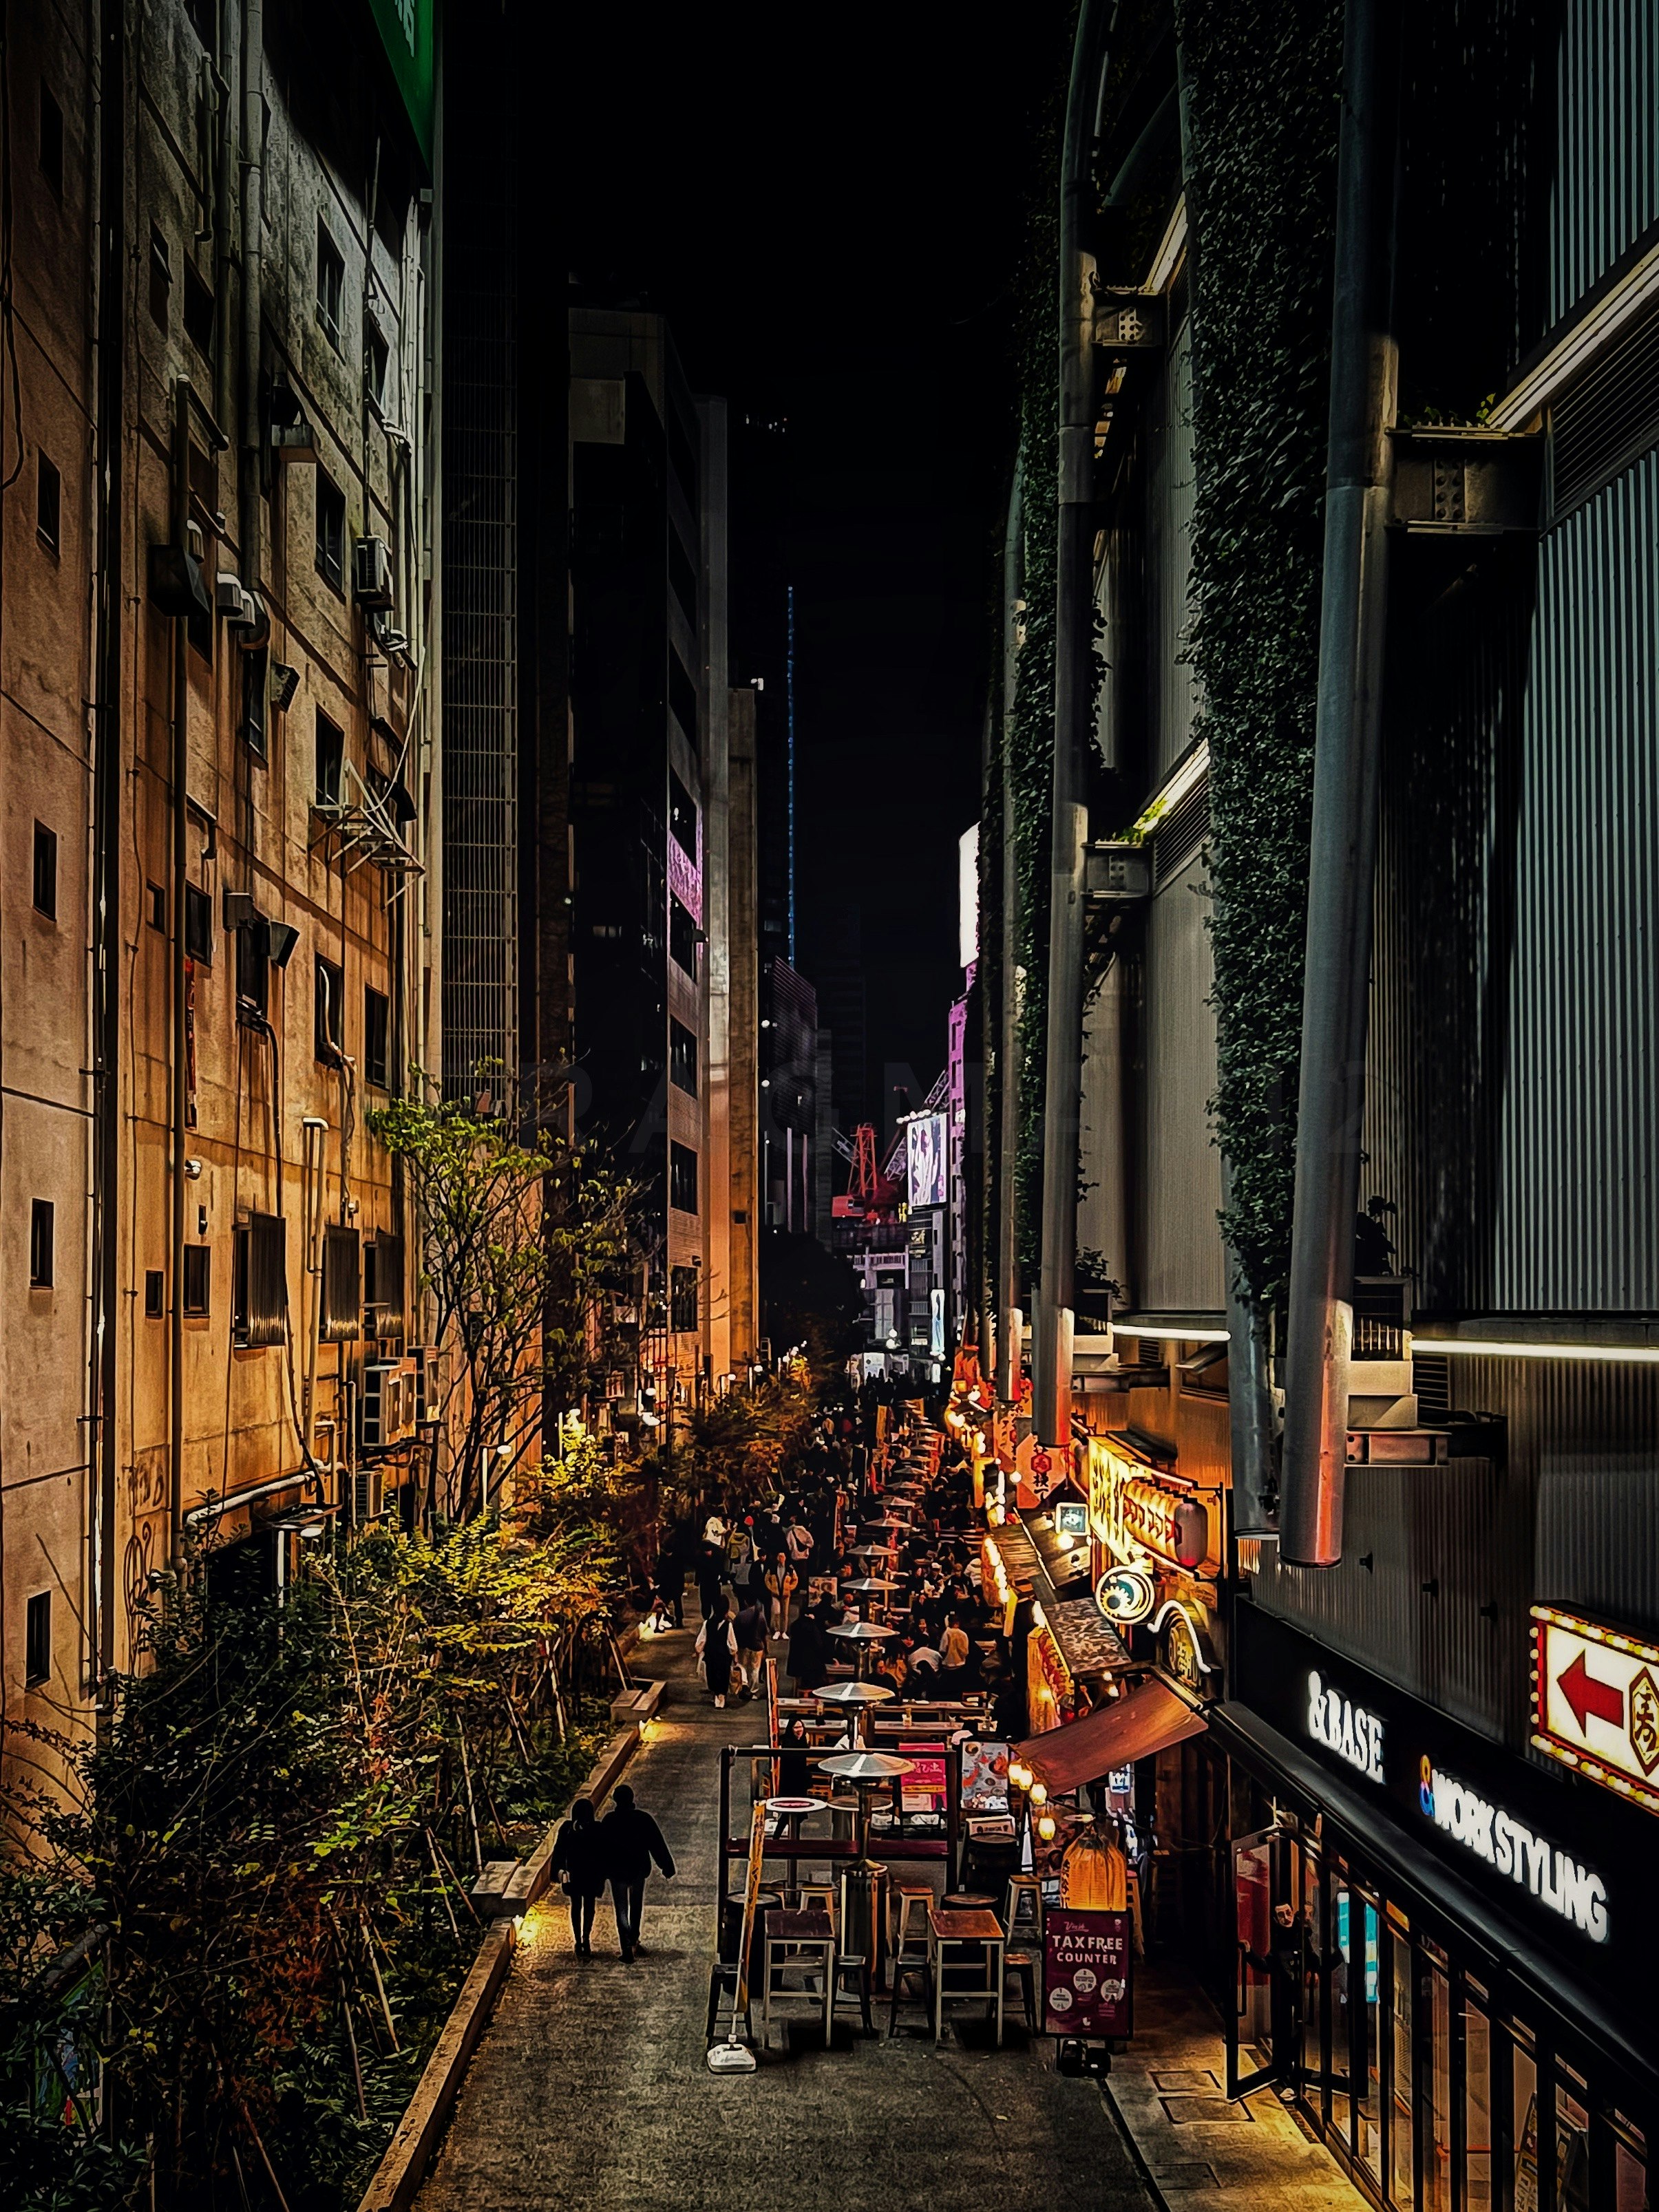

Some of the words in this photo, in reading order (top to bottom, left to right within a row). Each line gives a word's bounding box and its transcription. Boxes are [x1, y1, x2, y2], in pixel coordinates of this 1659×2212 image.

[1309, 1670, 1384, 1784] &BASE
[1494, 1810, 1607, 1942] STYLING
[1053, 1935, 1086, 1949] TAX
[1088, 1937, 1123, 1952] FREE
[1057, 1953, 1117, 1965] COUNTER
